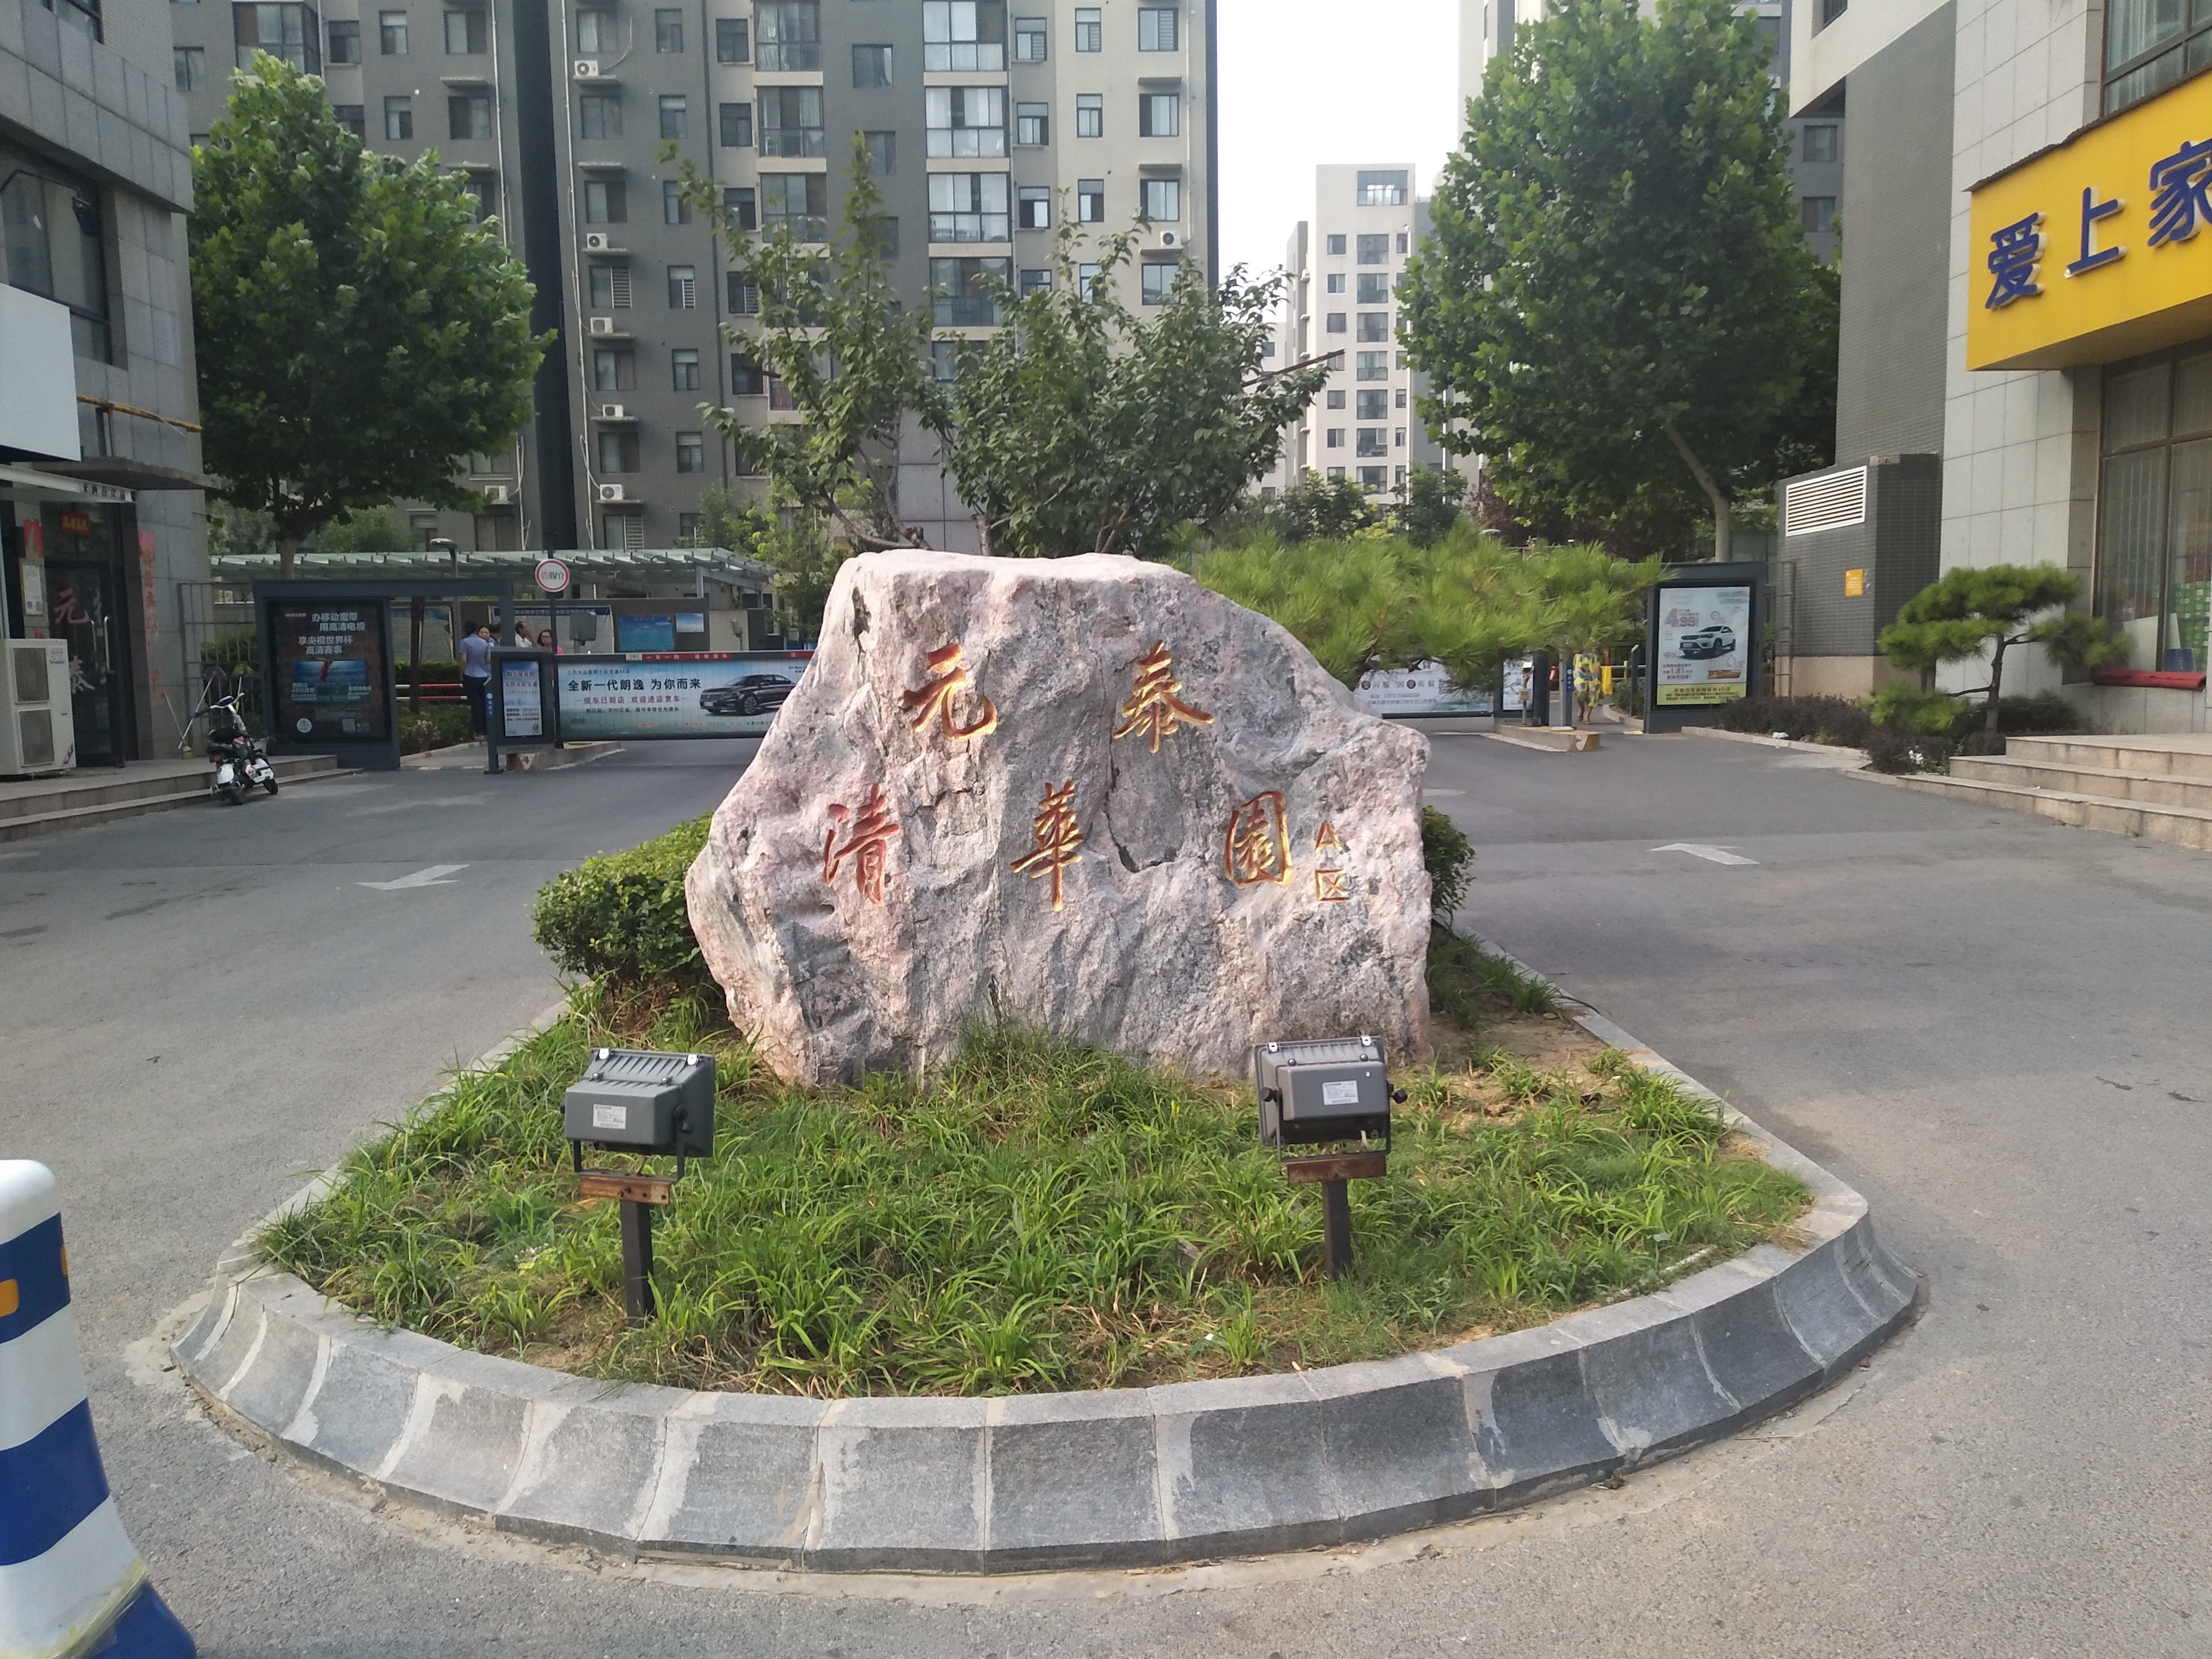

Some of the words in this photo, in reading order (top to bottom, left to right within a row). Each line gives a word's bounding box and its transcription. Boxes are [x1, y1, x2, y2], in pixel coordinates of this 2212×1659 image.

[1984, 139, 2212, 310] 爱上家
[312, 613, 358, 622] 办移动宽带
[320, 622, 365, 631] 用高清电视
[298, 635, 353, 645] 享央视世界杯
[306, 645, 343, 655] 高清赛事
[568, 679, 644, 692] 全新一代朗逸
[651, 677, 701, 691] 为你而来
[584, 696, 624, 705] 现车已到店
[631, 695, 681, 704] 欢迎进店赏车
[903, 639, 1215, 753] 元泰
